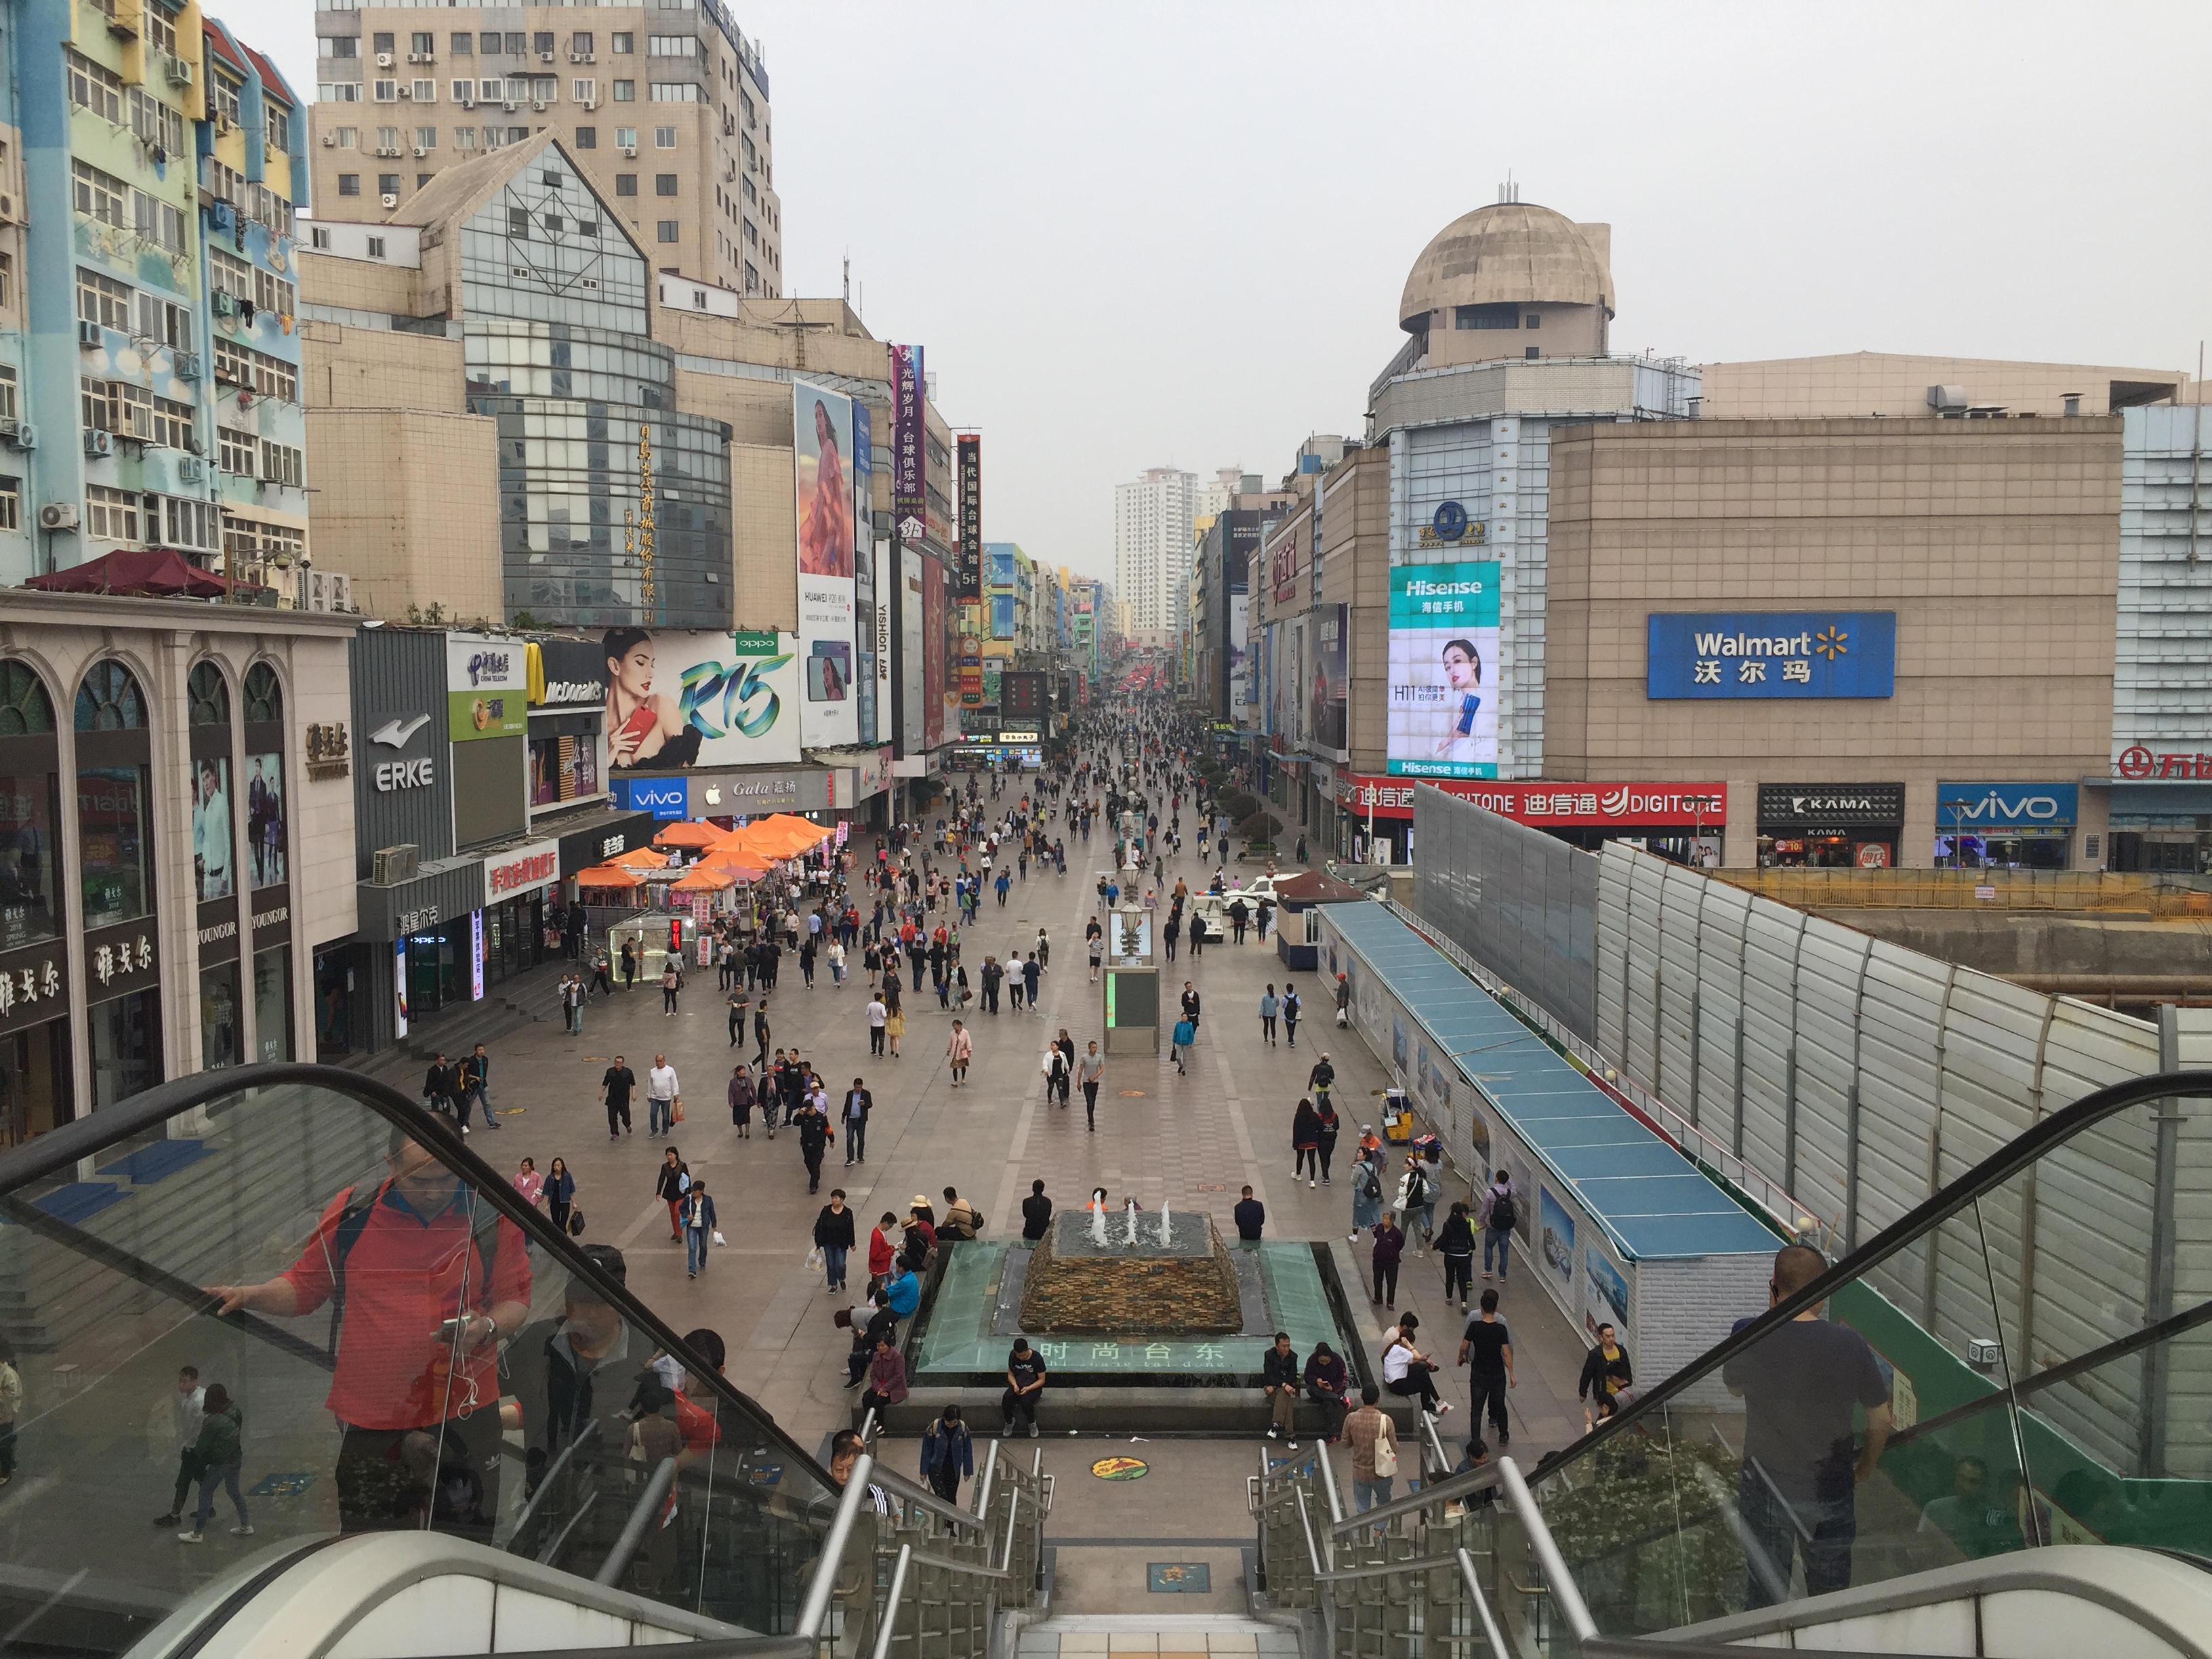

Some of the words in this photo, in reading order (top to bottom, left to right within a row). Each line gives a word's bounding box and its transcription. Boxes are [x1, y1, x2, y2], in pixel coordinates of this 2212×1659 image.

[967, 452, 979, 565] 当代国际台球会馆
[901, 521, 922, 537] 3F
[805, 592, 827, 602] HUAWEI
[1406, 580, 1482, 597] Hisense
[1422, 600, 1464, 613] 海信手机
[1694, 631, 1811, 658] Walmart
[1694, 660, 1811, 684] 沃尔玛
[545, 680, 602, 703] McDonald's
[680, 653, 794, 739] R15
[1395, 685, 1415, 701] H11
[375, 758, 433, 792] ERKE
[1401, 762, 1451, 774] Hisense
[1454, 766, 1482, 775] 海信手机
[636, 790, 682, 806] vivo
[733, 781, 769, 796] Gala
[1359, 787, 1414, 808] 迪信通
[1523, 794, 1597, 815] 迪信通
[1811, 800, 1871, 809] KAMA
[1957, 790, 2057, 819] vivo
[251, 907, 289, 930] YOUNGOR
[400, 905, 438, 937] 鸿星尔克
[6, 933, 26, 942] SPRING
[197, 921, 237, 945] YOUNGOR
[94, 935, 152, 987] 雅戈尔
[0, 960, 60, 1017] 雅戈尔
[1040, 1342, 1225, 1359] 时尚台东
